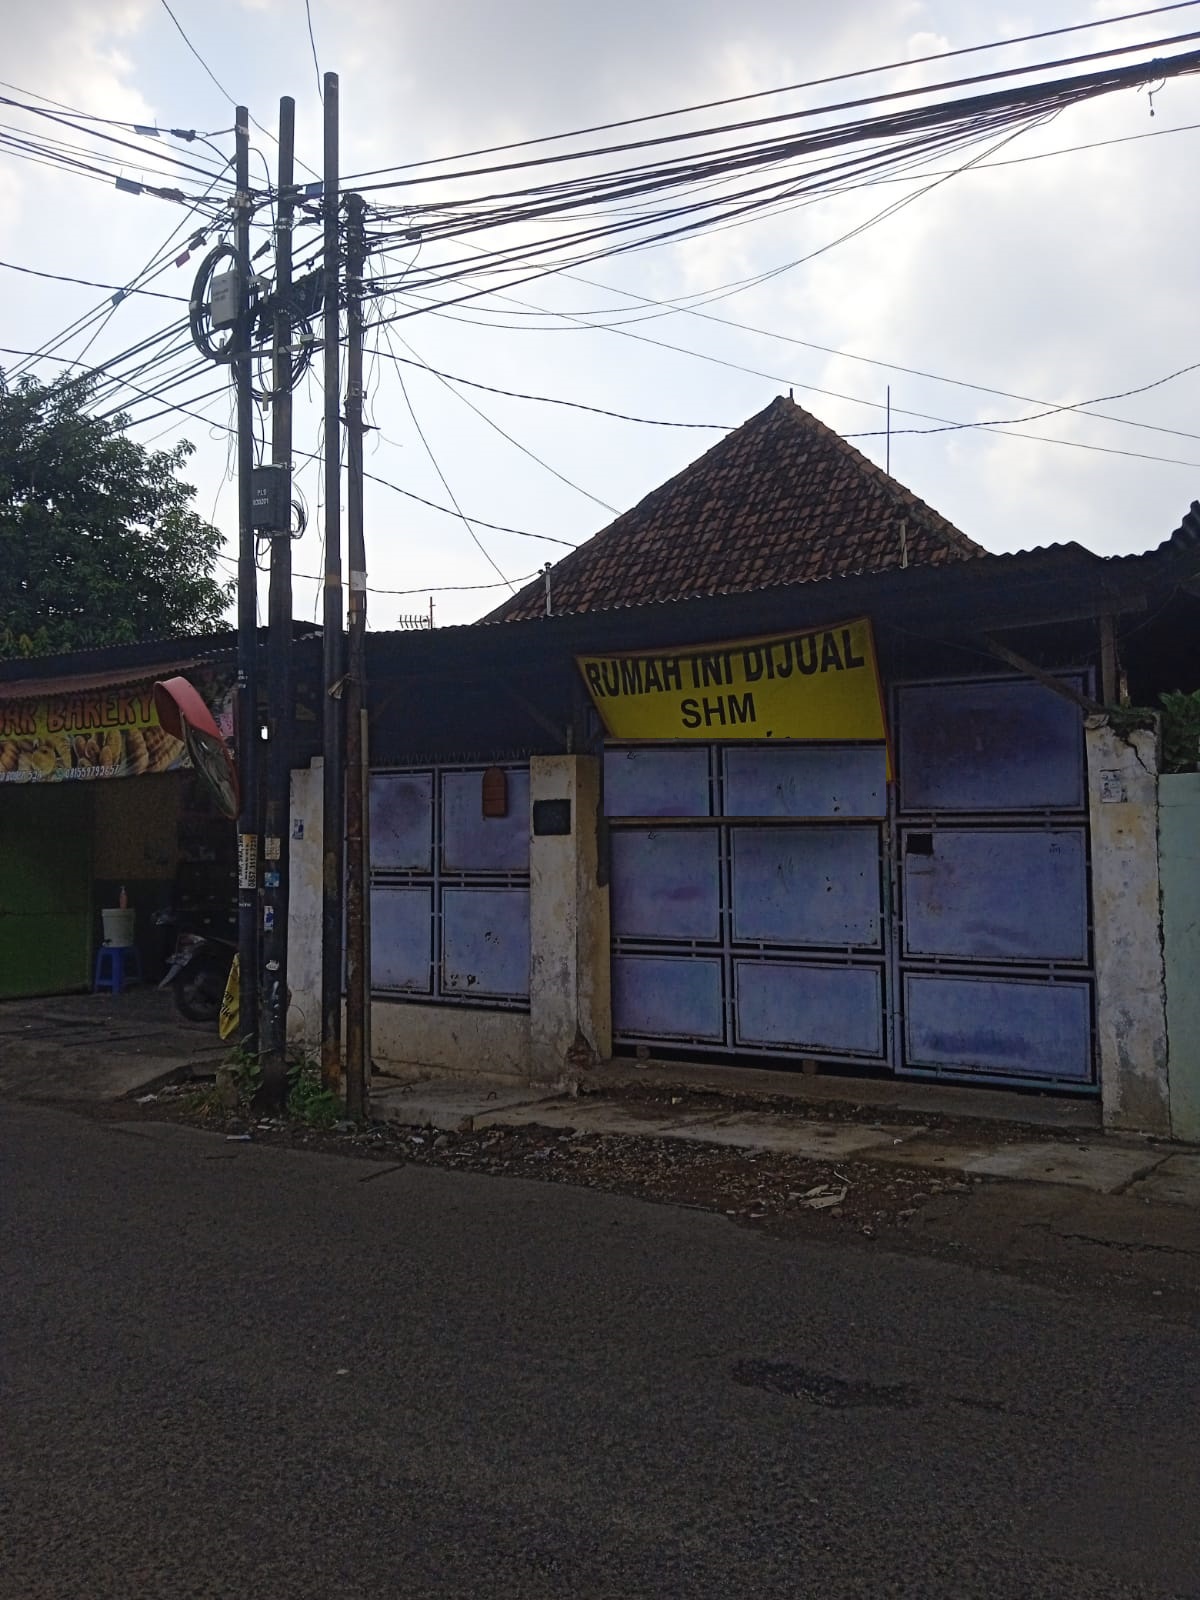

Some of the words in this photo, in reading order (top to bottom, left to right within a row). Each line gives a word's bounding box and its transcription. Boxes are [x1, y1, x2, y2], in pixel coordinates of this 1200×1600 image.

[585, 655, 682, 697] RUMAH
[692, 653, 734, 689] INI
[744, 629, 865, 683] DIJUAL
[47, 693, 153, 734] BAKERY
[680, 692, 757, 729] SHM
